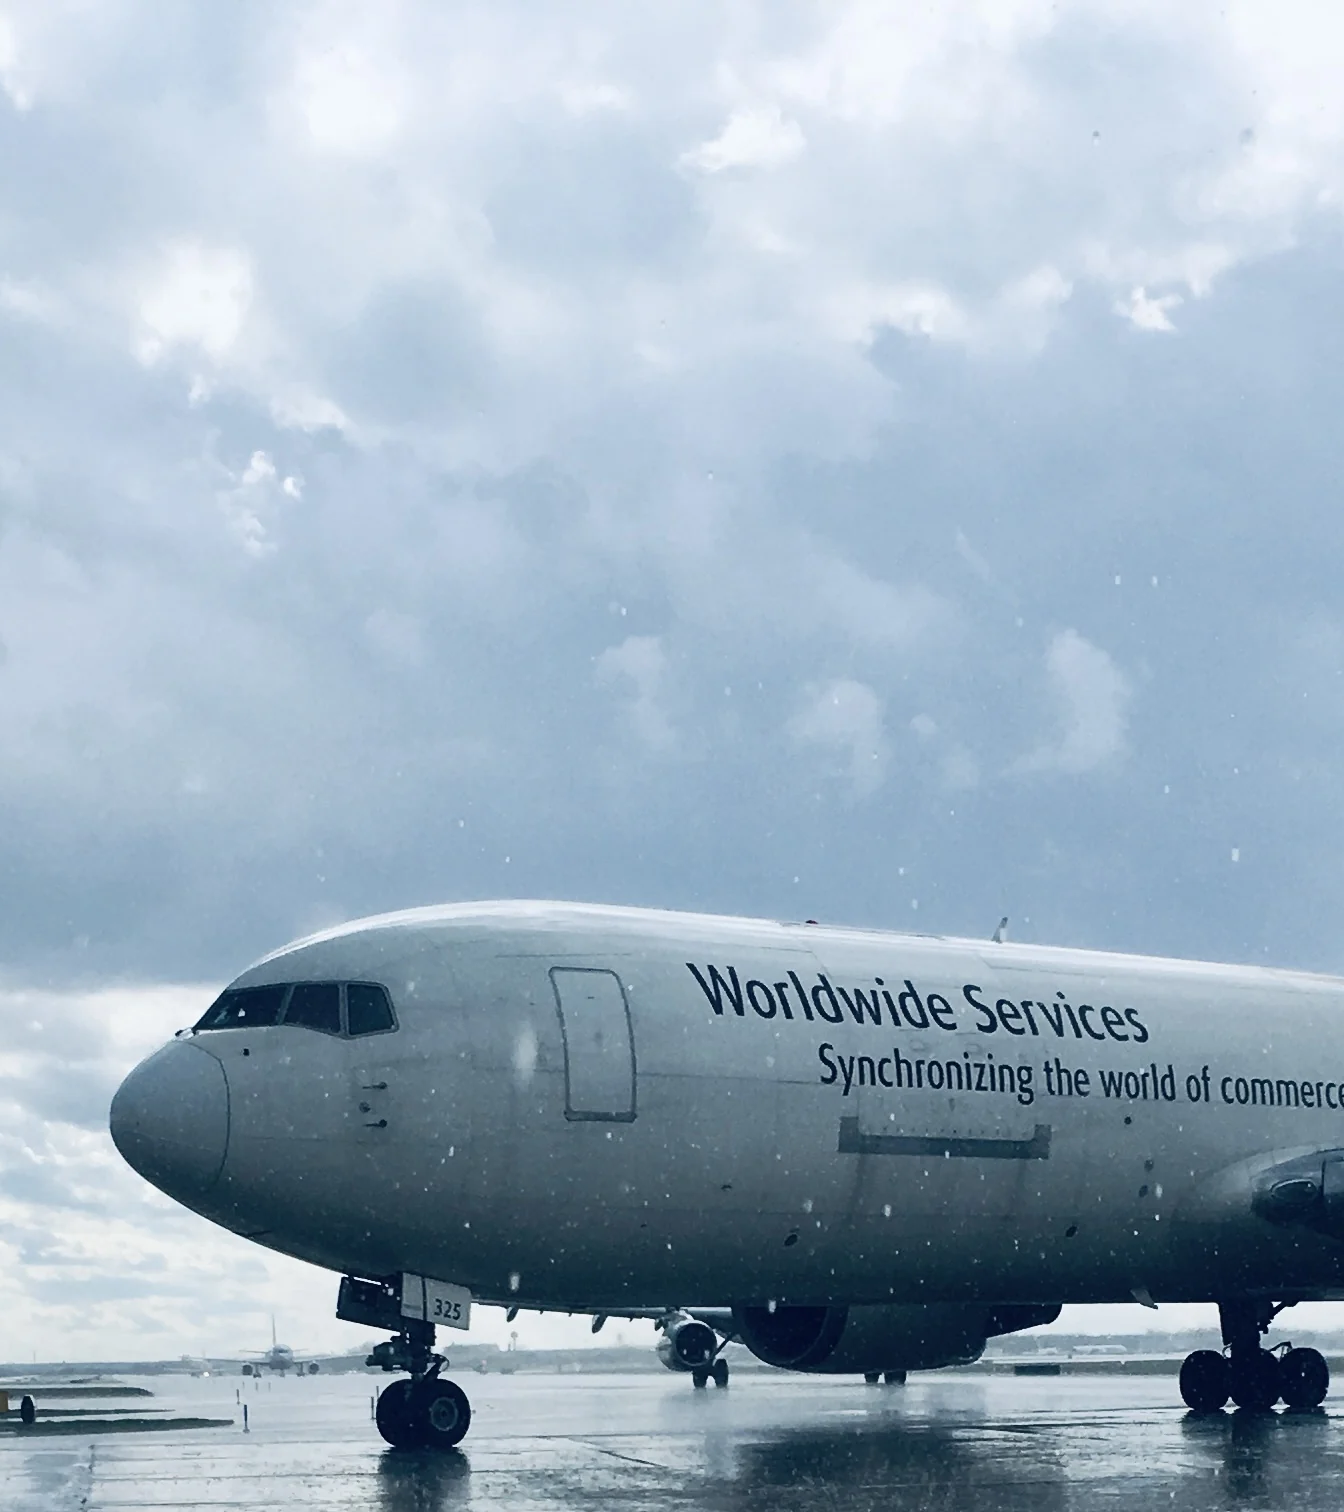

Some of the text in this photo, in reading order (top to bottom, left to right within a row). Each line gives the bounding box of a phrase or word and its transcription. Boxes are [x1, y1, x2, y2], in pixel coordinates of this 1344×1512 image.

[685, 961, 1150, 1044] Worldwide Services
[818, 1041, 1035, 1106] Synchronizing
[1041, 1056, 1091, 1098] the
[1098, 1062, 1176, 1102] world
[1185, 1063, 1211, 1103] of
[433, 1298, 462, 1321] 325
